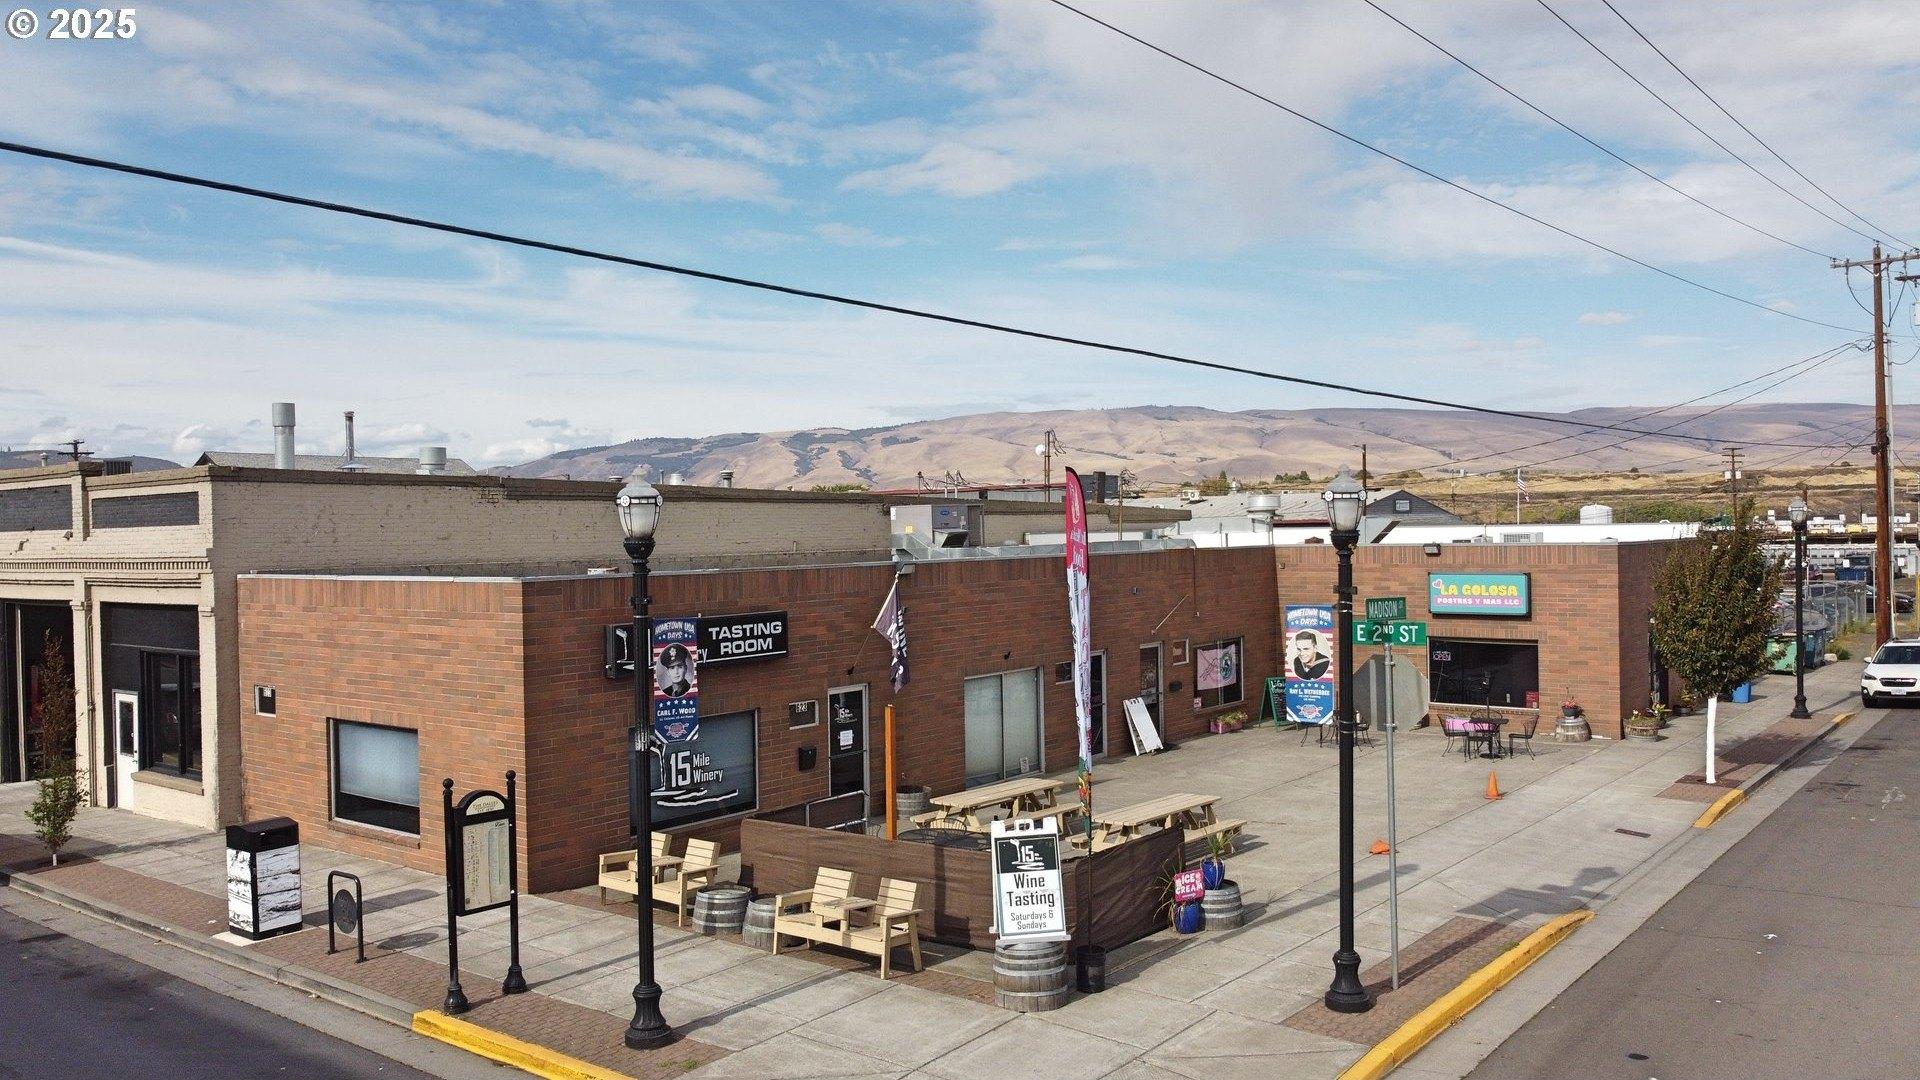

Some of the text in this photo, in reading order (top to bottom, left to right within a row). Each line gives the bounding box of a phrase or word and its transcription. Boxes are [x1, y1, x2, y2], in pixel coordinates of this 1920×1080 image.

[1440, 584, 1518, 596] LA GOLOSA
[1368, 601, 1398, 618] MADISON
[708, 621, 782, 640] TASTING
[1357, 624, 1418, 642] E 2ND ST
[720, 637, 773, 655] ROOM
[1433, 652, 1451, 661] OPEN
[693, 753, 710, 767] Mile
[670, 751, 690, 787] 15
[693, 769, 723, 783] Winery
[1021, 845, 1034, 862] 15
[1014, 873, 1045, 889] Wine
[1181, 874, 1196, 885] ICE
[1175, 882, 1203, 895] CREAM
[1006, 891, 1055, 908] Tasting
[1010, 910, 1054, 922] Saturdays &
[1017, 920, 1047, 930] Sundays
